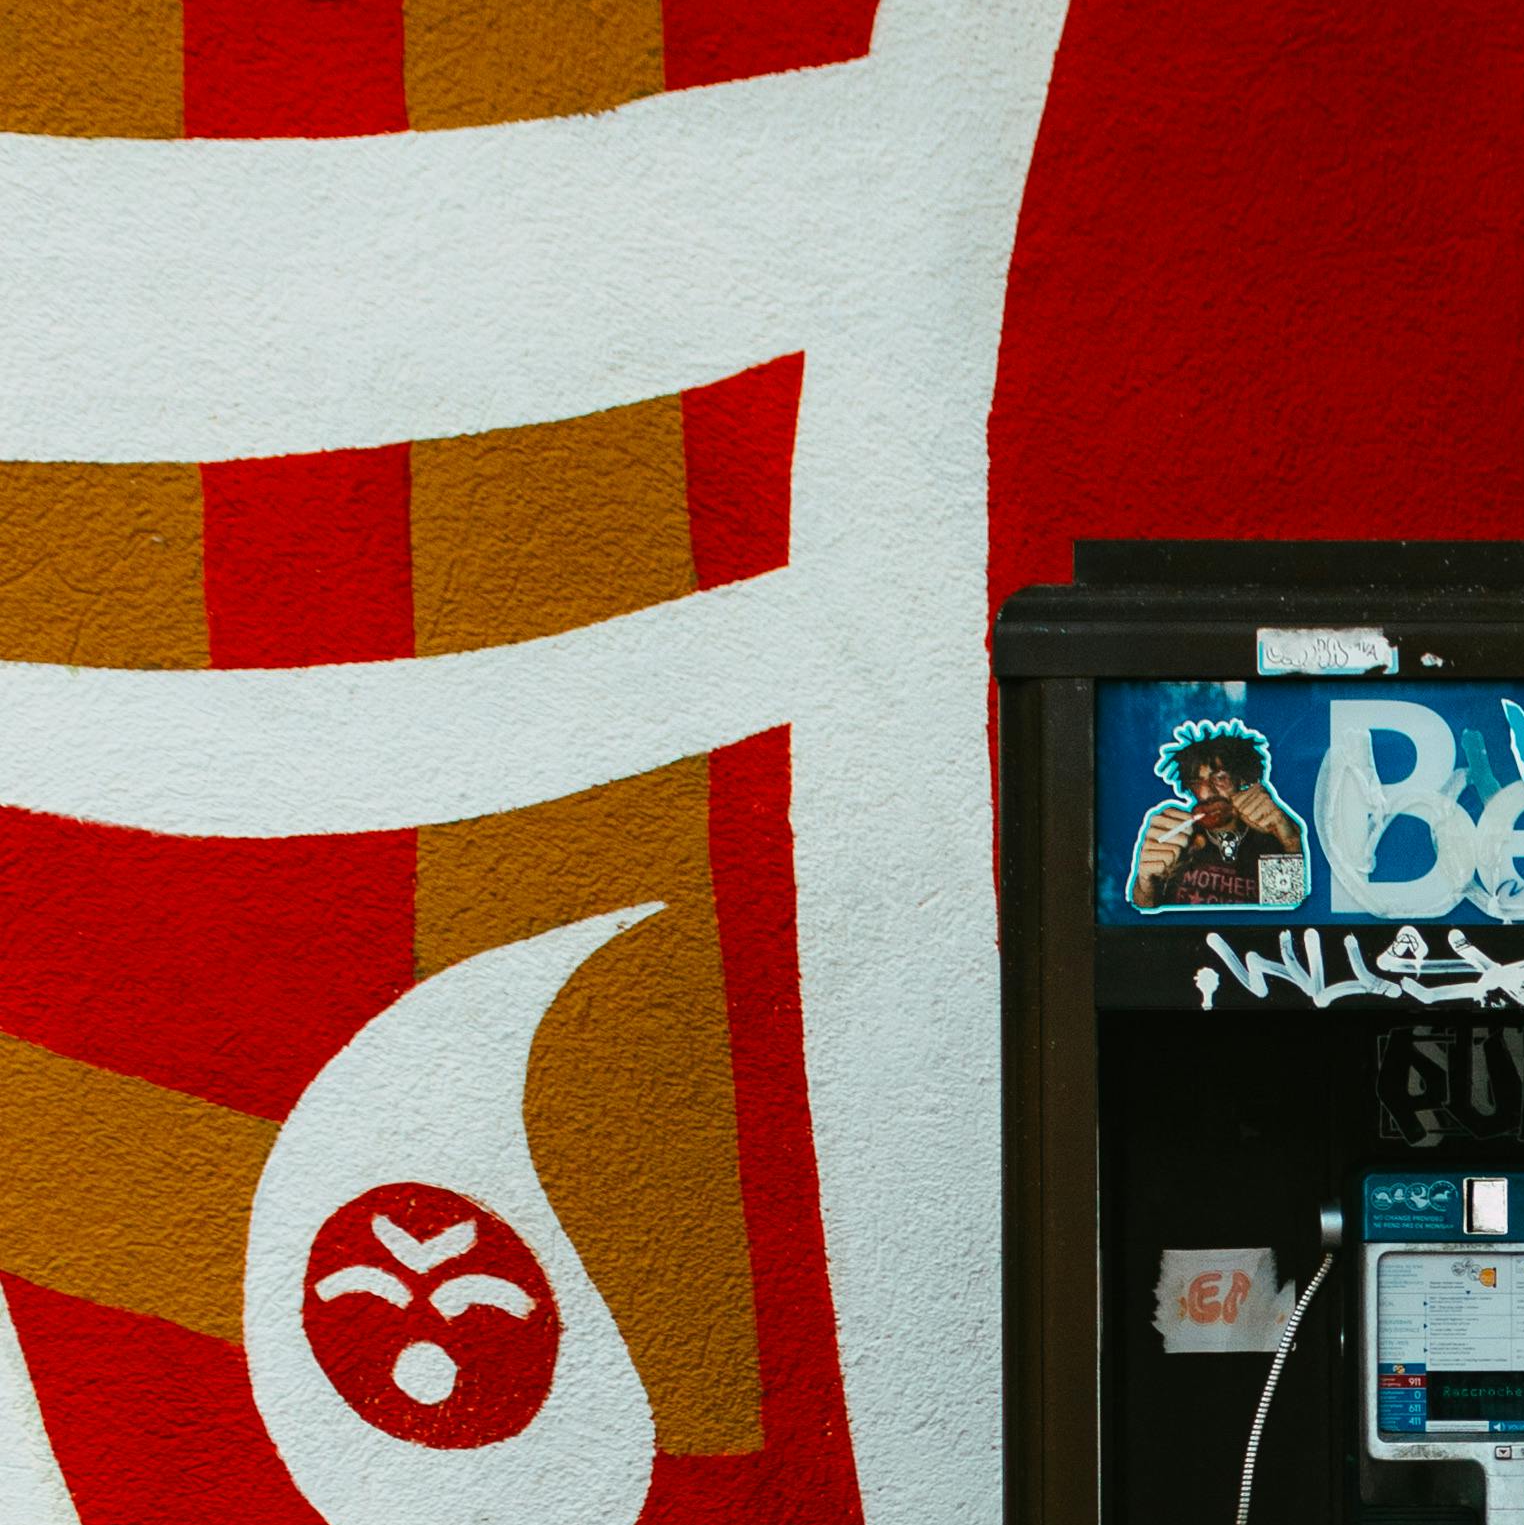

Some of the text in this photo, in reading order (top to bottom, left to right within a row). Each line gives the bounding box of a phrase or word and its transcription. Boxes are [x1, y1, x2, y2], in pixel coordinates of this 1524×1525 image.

[1408, 1377, 1422, 1387] 911
[1408, 1404, 1422, 1413] 611
[1407, 1416, 1422, 1426] 411
